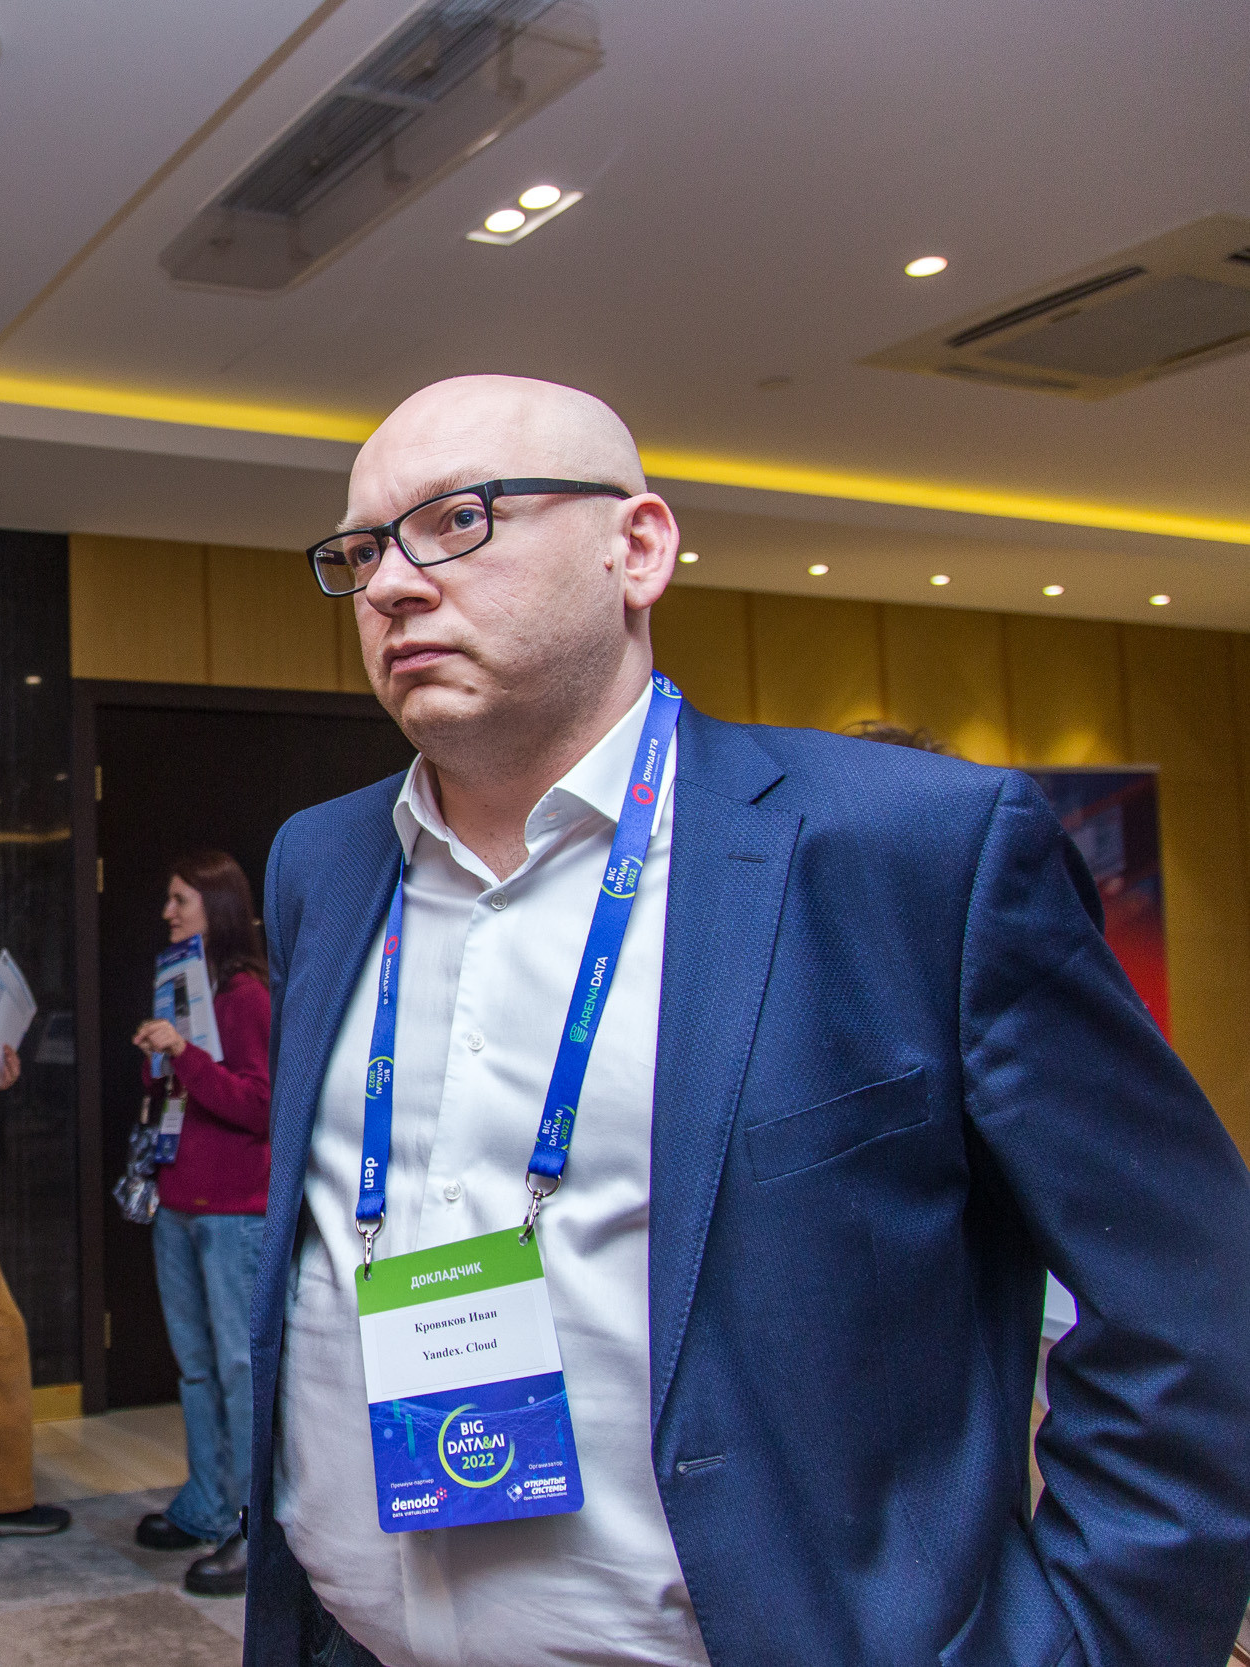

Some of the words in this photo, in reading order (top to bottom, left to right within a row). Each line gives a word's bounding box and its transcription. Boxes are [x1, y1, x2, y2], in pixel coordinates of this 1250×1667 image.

[606, 867, 617, 881] BIG
[613, 858, 630, 892] DATA&AI
[625, 868, 638, 888] 2022
[579, 956, 608, 1029] ARENADATA
[368, 1070, 376, 1089] 2022
[542, 1119, 552, 1135] BIG
[549, 1109, 563, 1146] DATA&AI
[560, 1118, 570, 1140] 2022
[364, 1157, 378, 1189] den
[411, 1262, 483, 1290] ДОКЛАДЧИК
[414, 1317, 466, 1334] Кровяков
[469, 1310, 497, 1322] Иван
[422, 1347, 463, 1361] Yandex.
[466, 1338, 497, 1353] Cloud
[460, 1419, 484, 1436] BIG
[447, 1433, 505, 1455] DATA&AI
[461, 1452, 495, 1470] 2022
[528, 1460, 563, 1470] Организатор
[524, 1476, 566, 1488] ОТКРЫТЫЕ
[531, 1484, 567, 1495] СИСТЕМЫ
[391, 1493, 438, 1511] denodo
